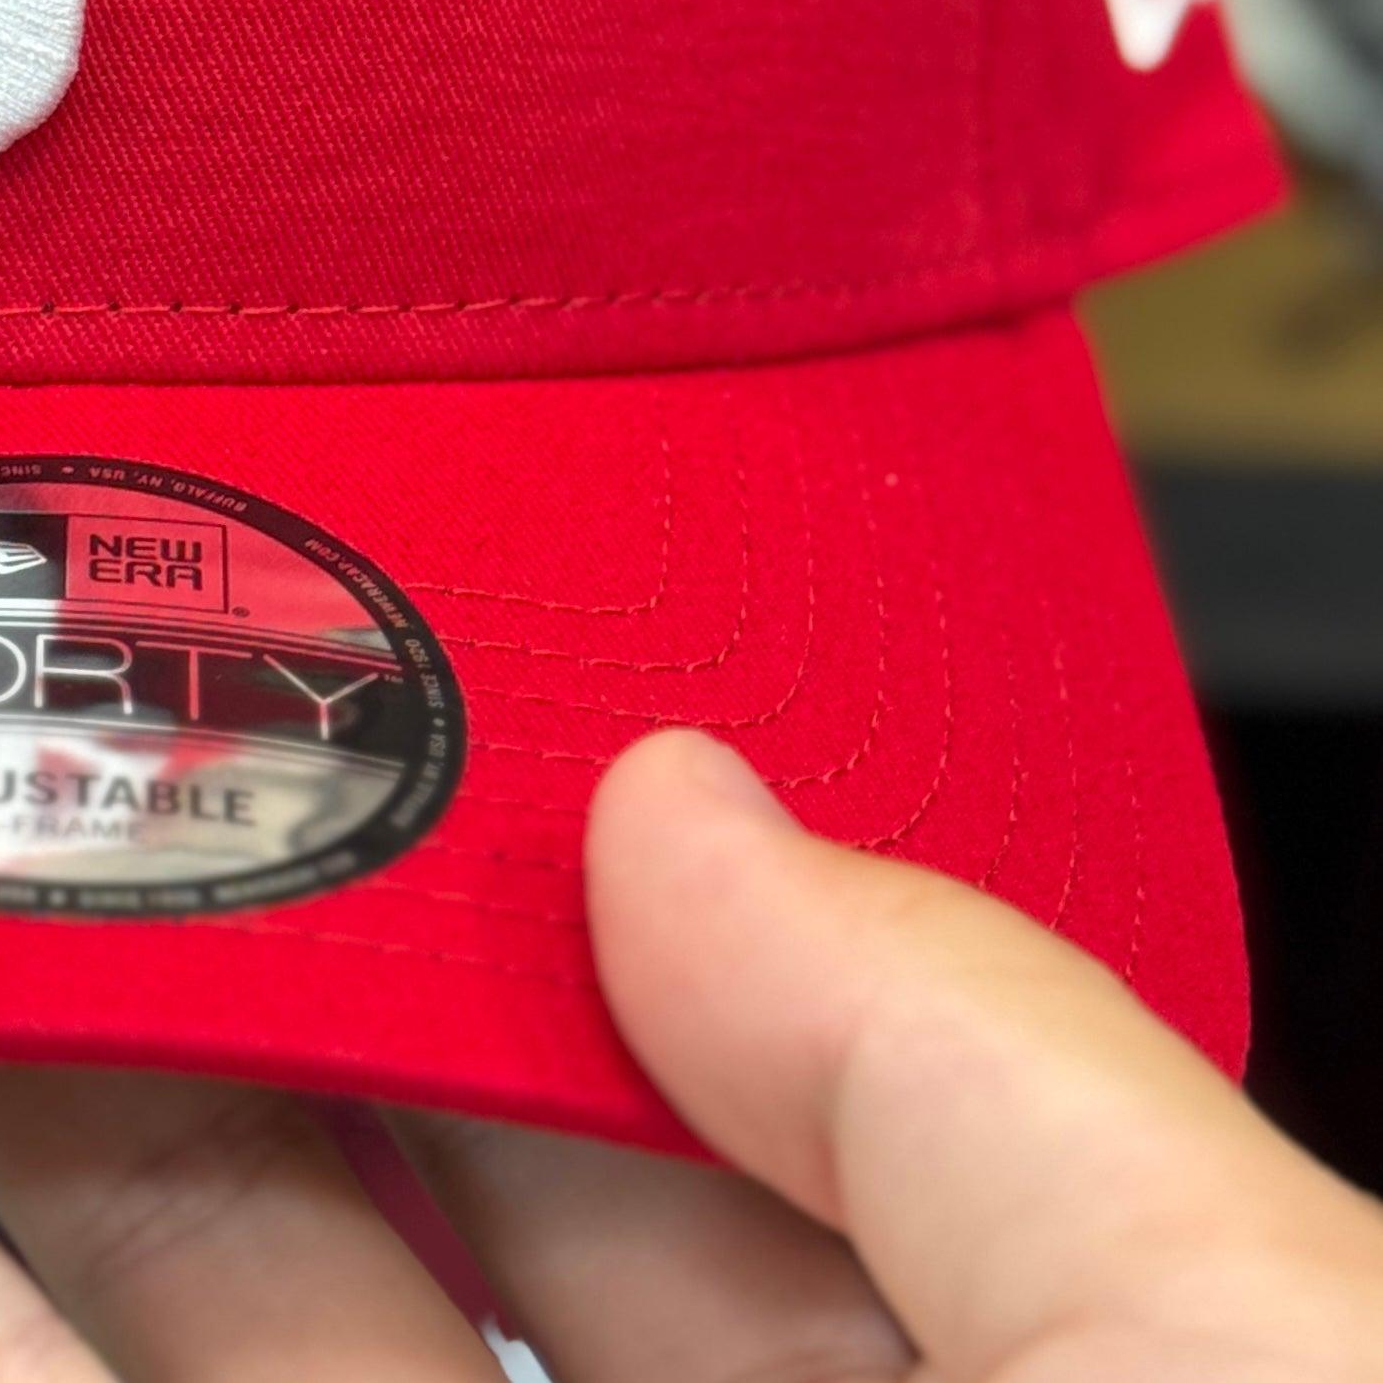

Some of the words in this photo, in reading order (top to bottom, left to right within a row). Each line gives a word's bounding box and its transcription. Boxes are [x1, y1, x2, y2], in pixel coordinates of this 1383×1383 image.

[89, 466, 126, 481] USA
[89, 533, 202, 563] NEW
[88, 561, 203, 592] ERA
